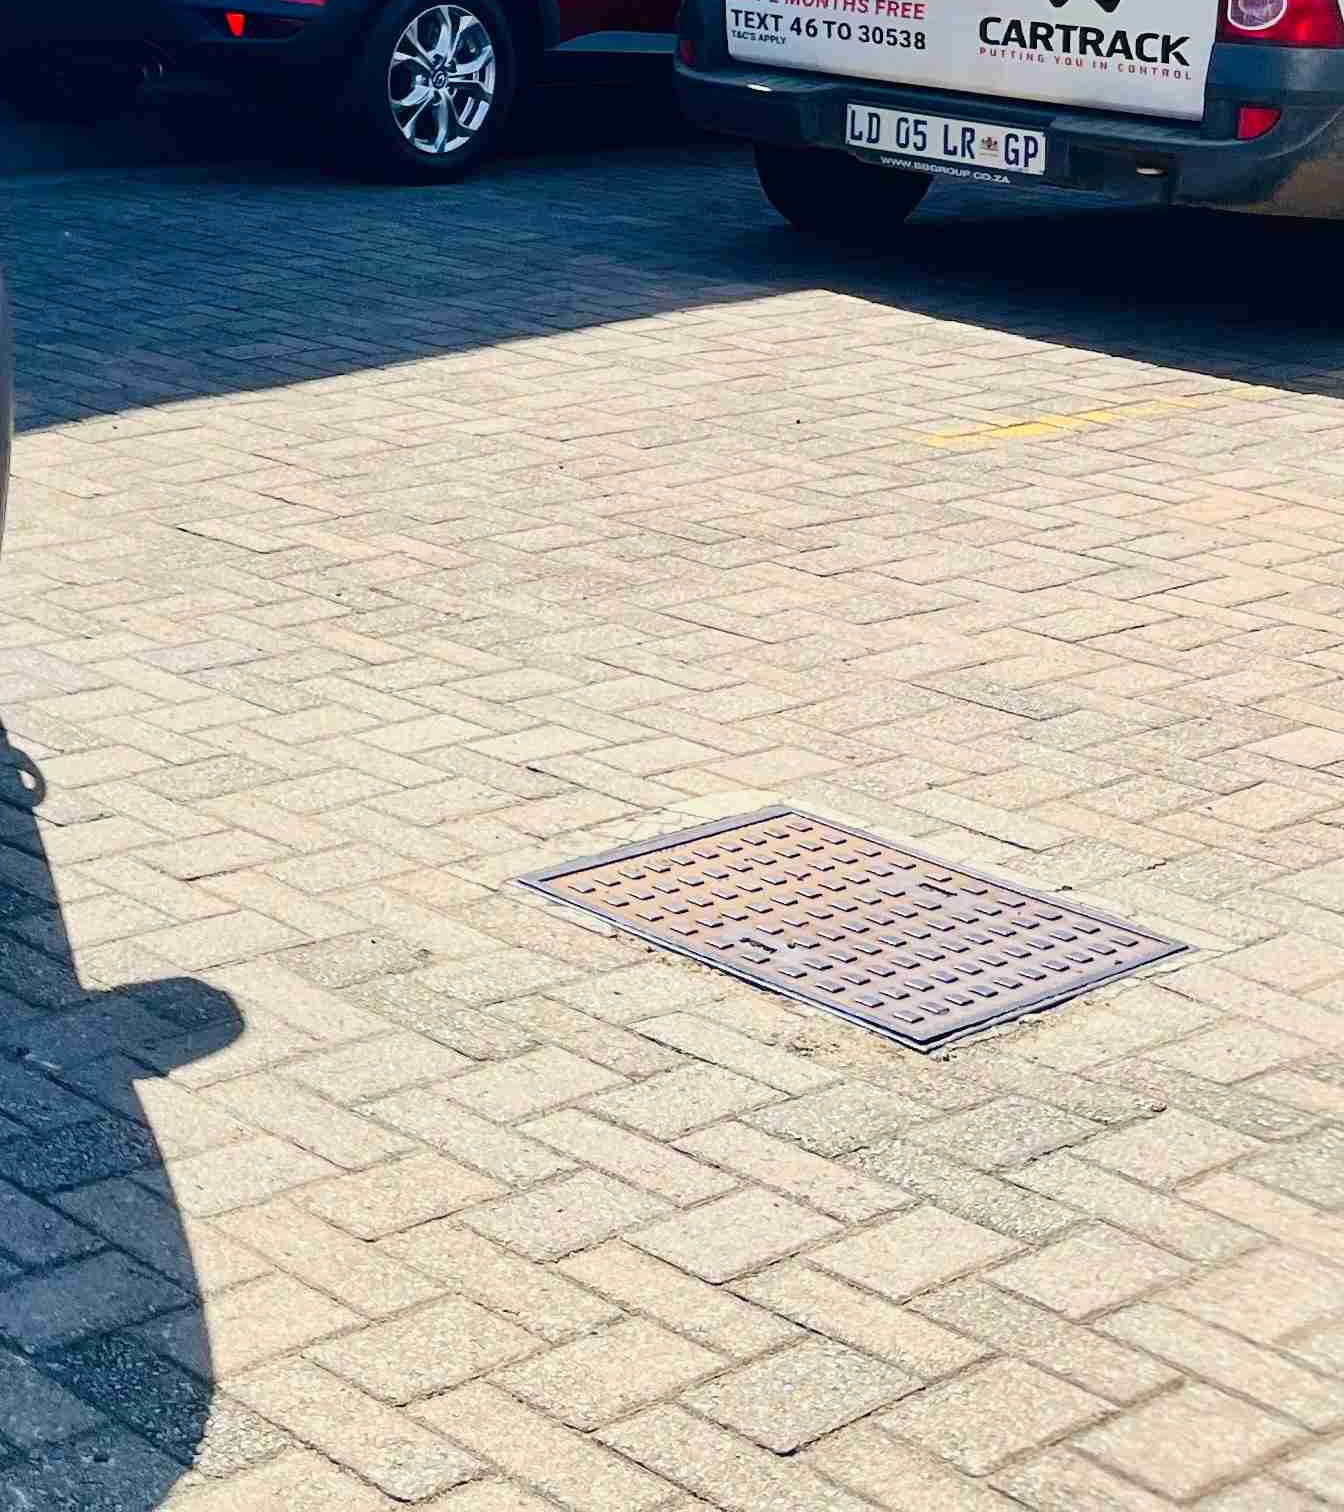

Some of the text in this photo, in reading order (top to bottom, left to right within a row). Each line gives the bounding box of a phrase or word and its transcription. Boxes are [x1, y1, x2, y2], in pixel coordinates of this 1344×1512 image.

[730, 8, 927, 50] TEXT 46 TO 30538
[875, 0, 926, 20] FREE
[757, 33, 787, 46] APPLY
[978, 16, 1192, 67] CARTRACK
[979, 46, 1192, 81] PUTTING YOU IN CONTROL
[849, 109, 1039, 168] LD 05 LR GP
